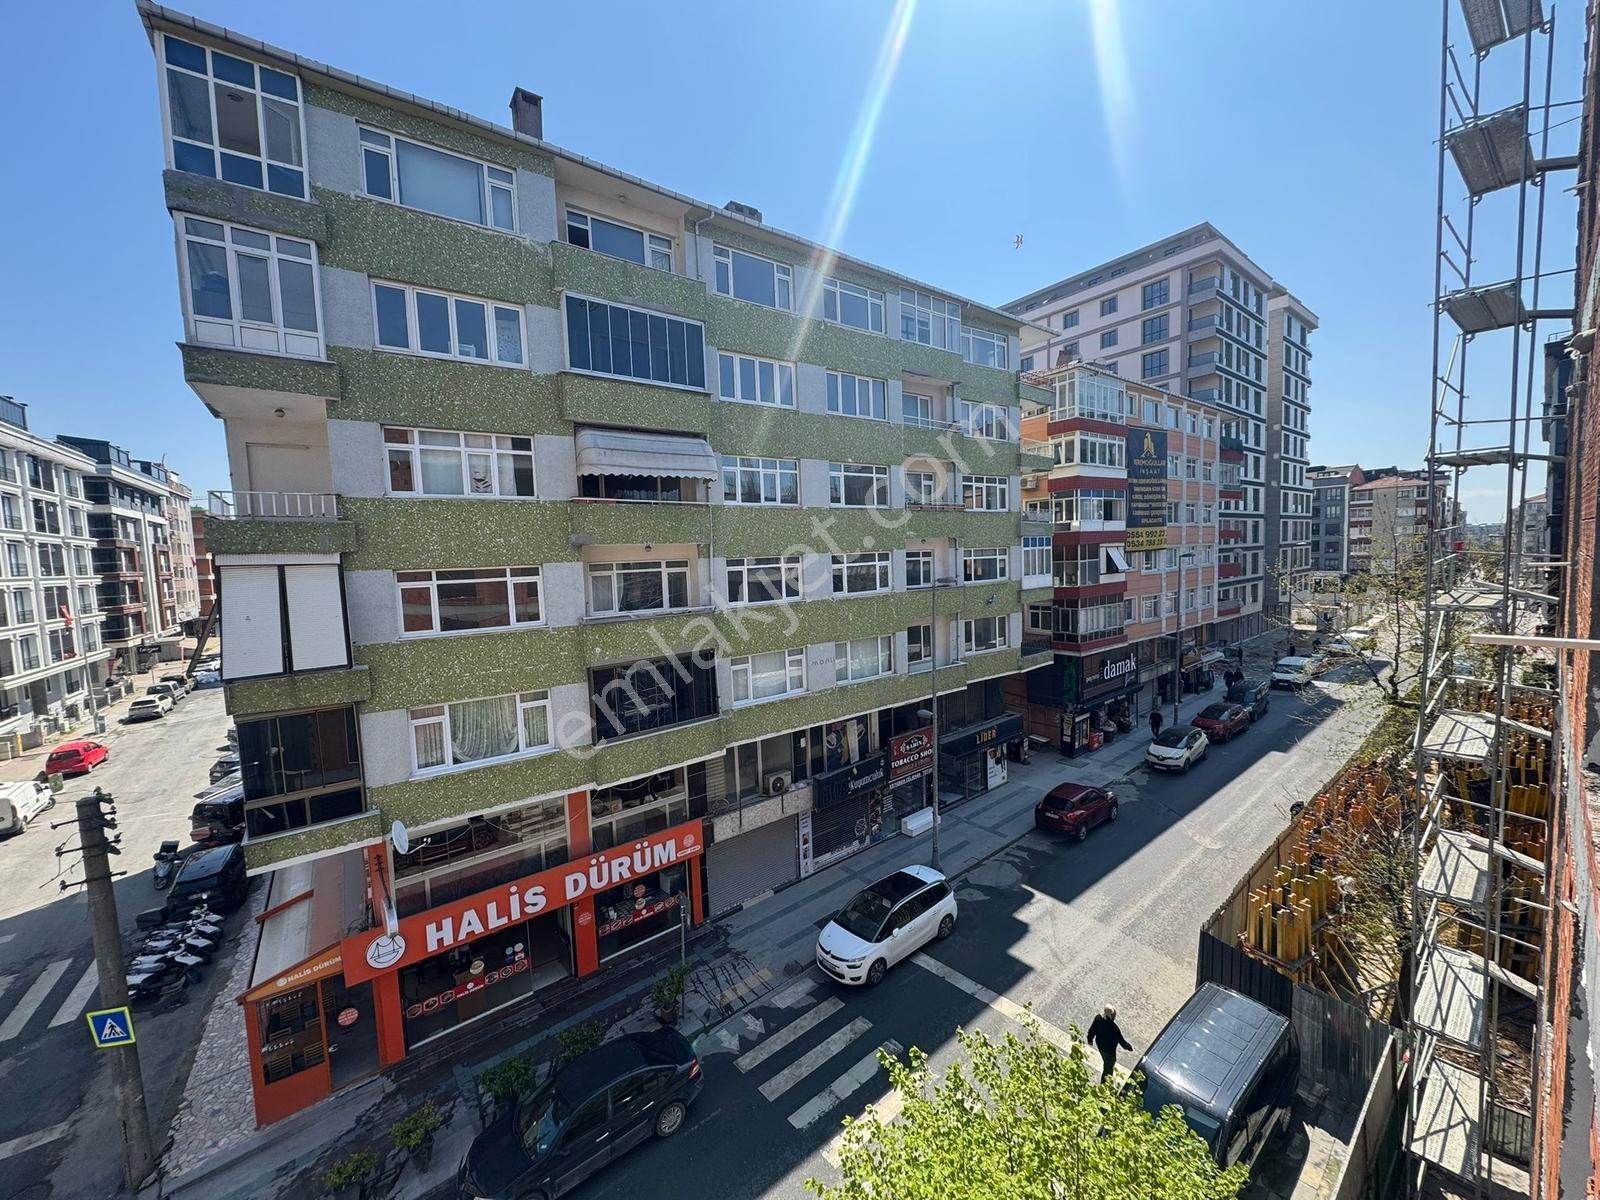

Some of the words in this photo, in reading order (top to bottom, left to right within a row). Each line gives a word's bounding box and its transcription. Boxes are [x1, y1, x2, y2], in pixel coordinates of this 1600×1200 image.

[1103, 652, 1137, 680] damak
[891, 753, 919, 769] TOBACCO
[920, 748, 933, 759] SHO
[425, 885, 547, 952] HALİS
[564, 840, 677, 901] DÜRÜM
[287, 968, 312, 983] HALİS
